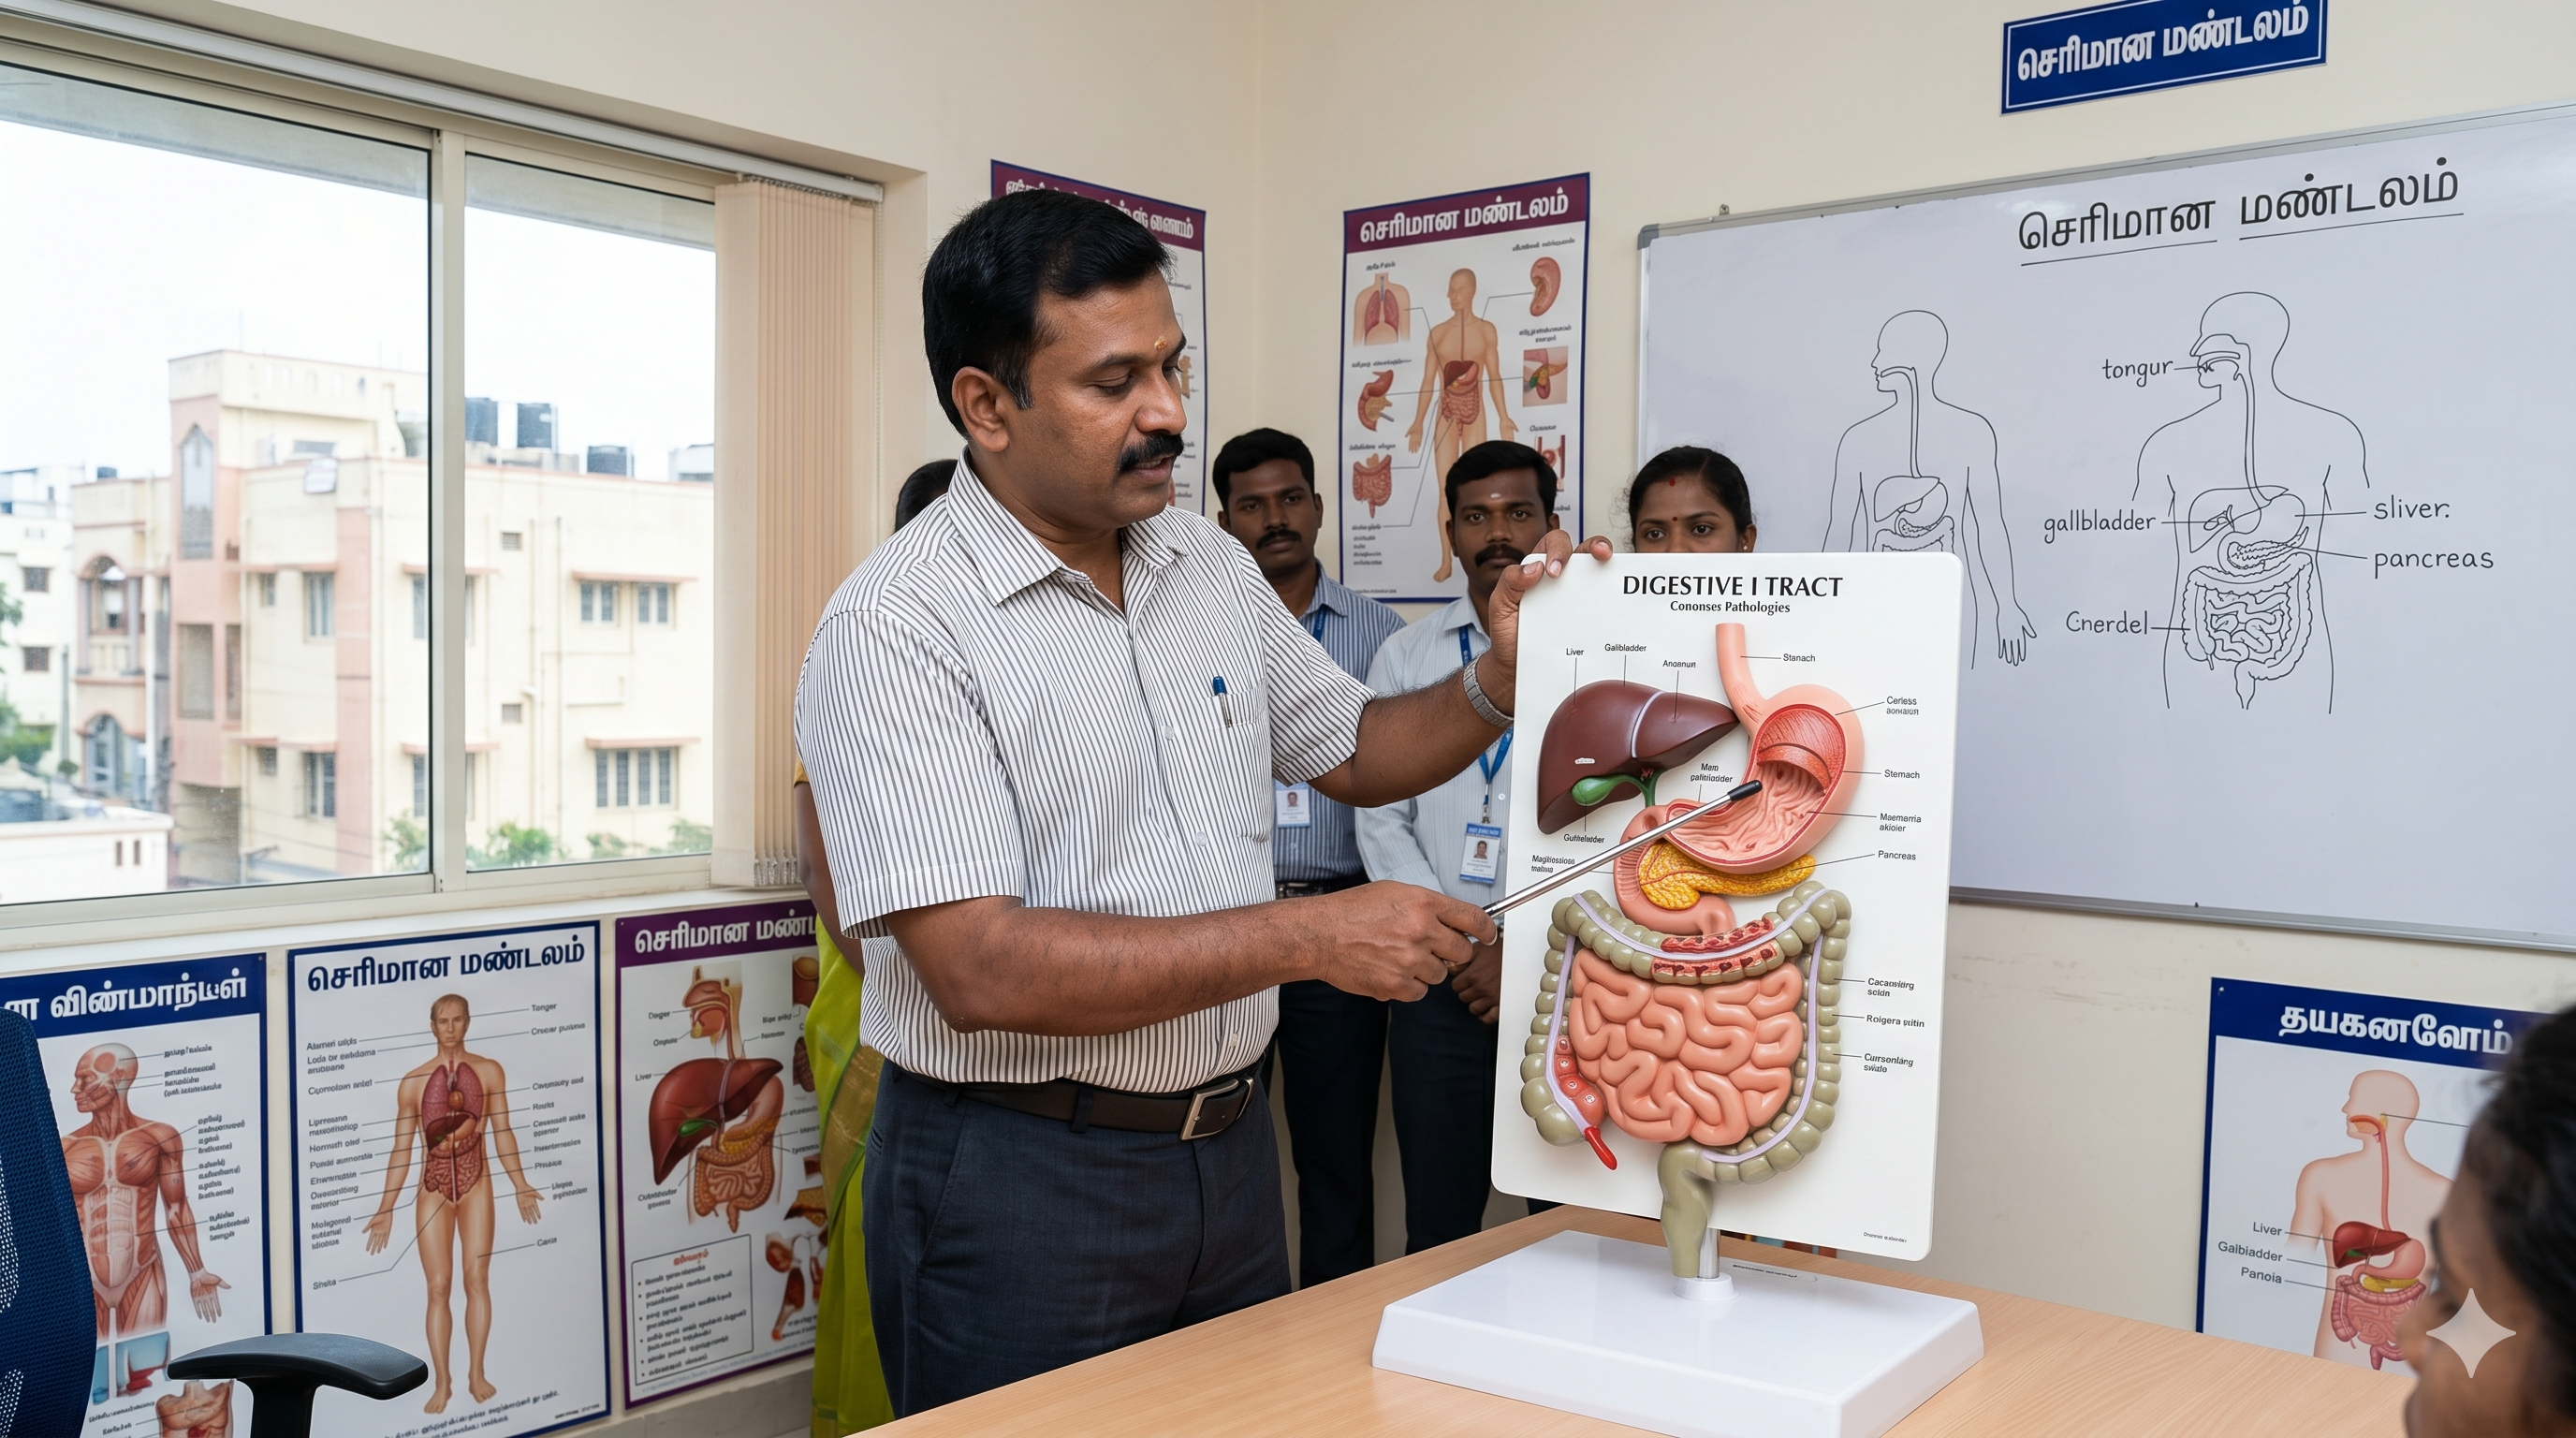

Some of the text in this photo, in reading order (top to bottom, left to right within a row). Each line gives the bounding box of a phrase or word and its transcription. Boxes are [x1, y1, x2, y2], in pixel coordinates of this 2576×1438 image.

[2017, 0, 2308, 81] செரிமான மண்டலம்
[1360, 186, 1569, 242] செரிமான மண்டலம்
[2018, 156, 2459, 250] செரிமான மண்டலம்
[2102, 358, 2174, 387] tongur
[2043, 508, 2157, 543] gallbladder
[2374, 549, 2494, 580] pancreas
[1623, 575, 1743, 595] DIGESTIVE
[1765, 577, 1843, 596] TRACT
[1670, 601, 1790, 616] Cononses Pathologies
[1566, 648, 1584, 656] Liver
[1884, 770, 1920, 779] Stemach
[1878, 850, 1916, 860] Pancreas
[635, 920, 750, 953] செரிமான
[308, 934, 585, 991] செரிமான மண்டலம்
[2253, 1222, 2282, 1236] Liver
[2241, 1267, 2282, 1284] Panoia
